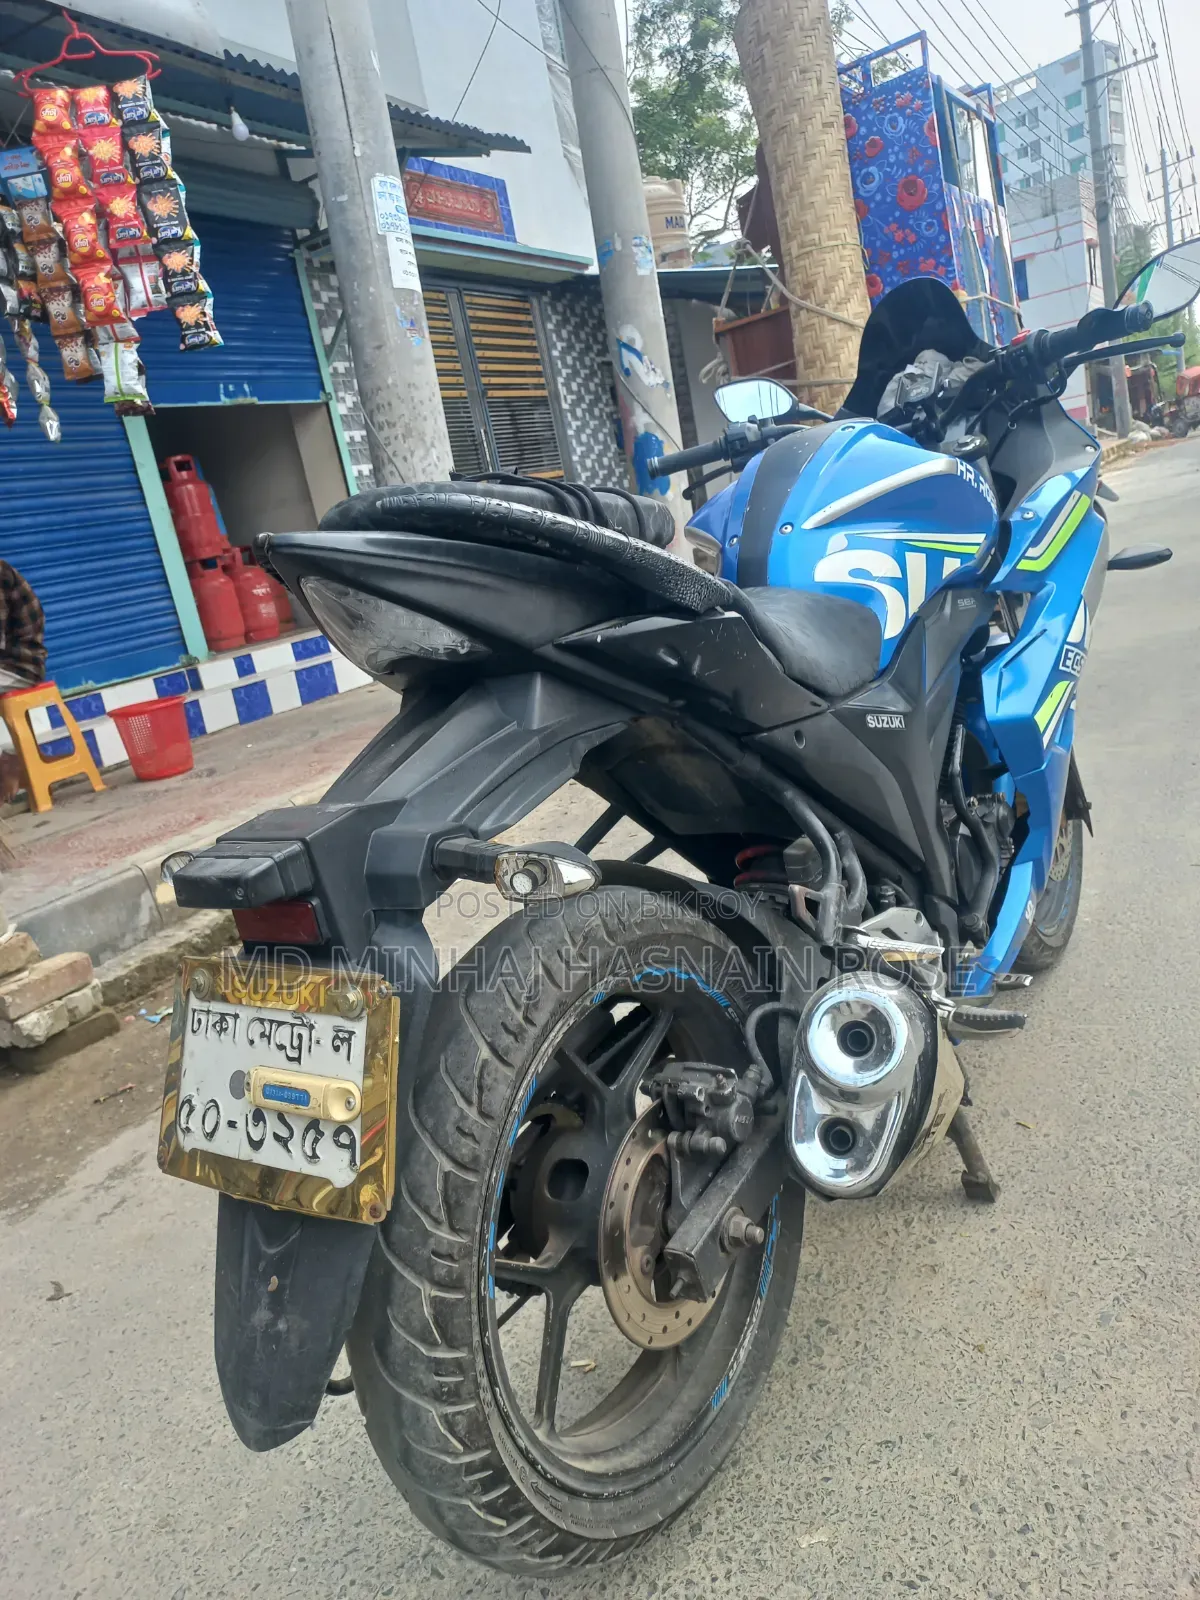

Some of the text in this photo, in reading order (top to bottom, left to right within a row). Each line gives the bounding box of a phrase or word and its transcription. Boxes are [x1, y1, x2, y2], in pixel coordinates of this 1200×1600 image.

[867, 714, 906, 729] SUZUKI
[233, 975, 326, 1007] SUZUKI
[191, 1007, 240, 1043] ঢাকা
